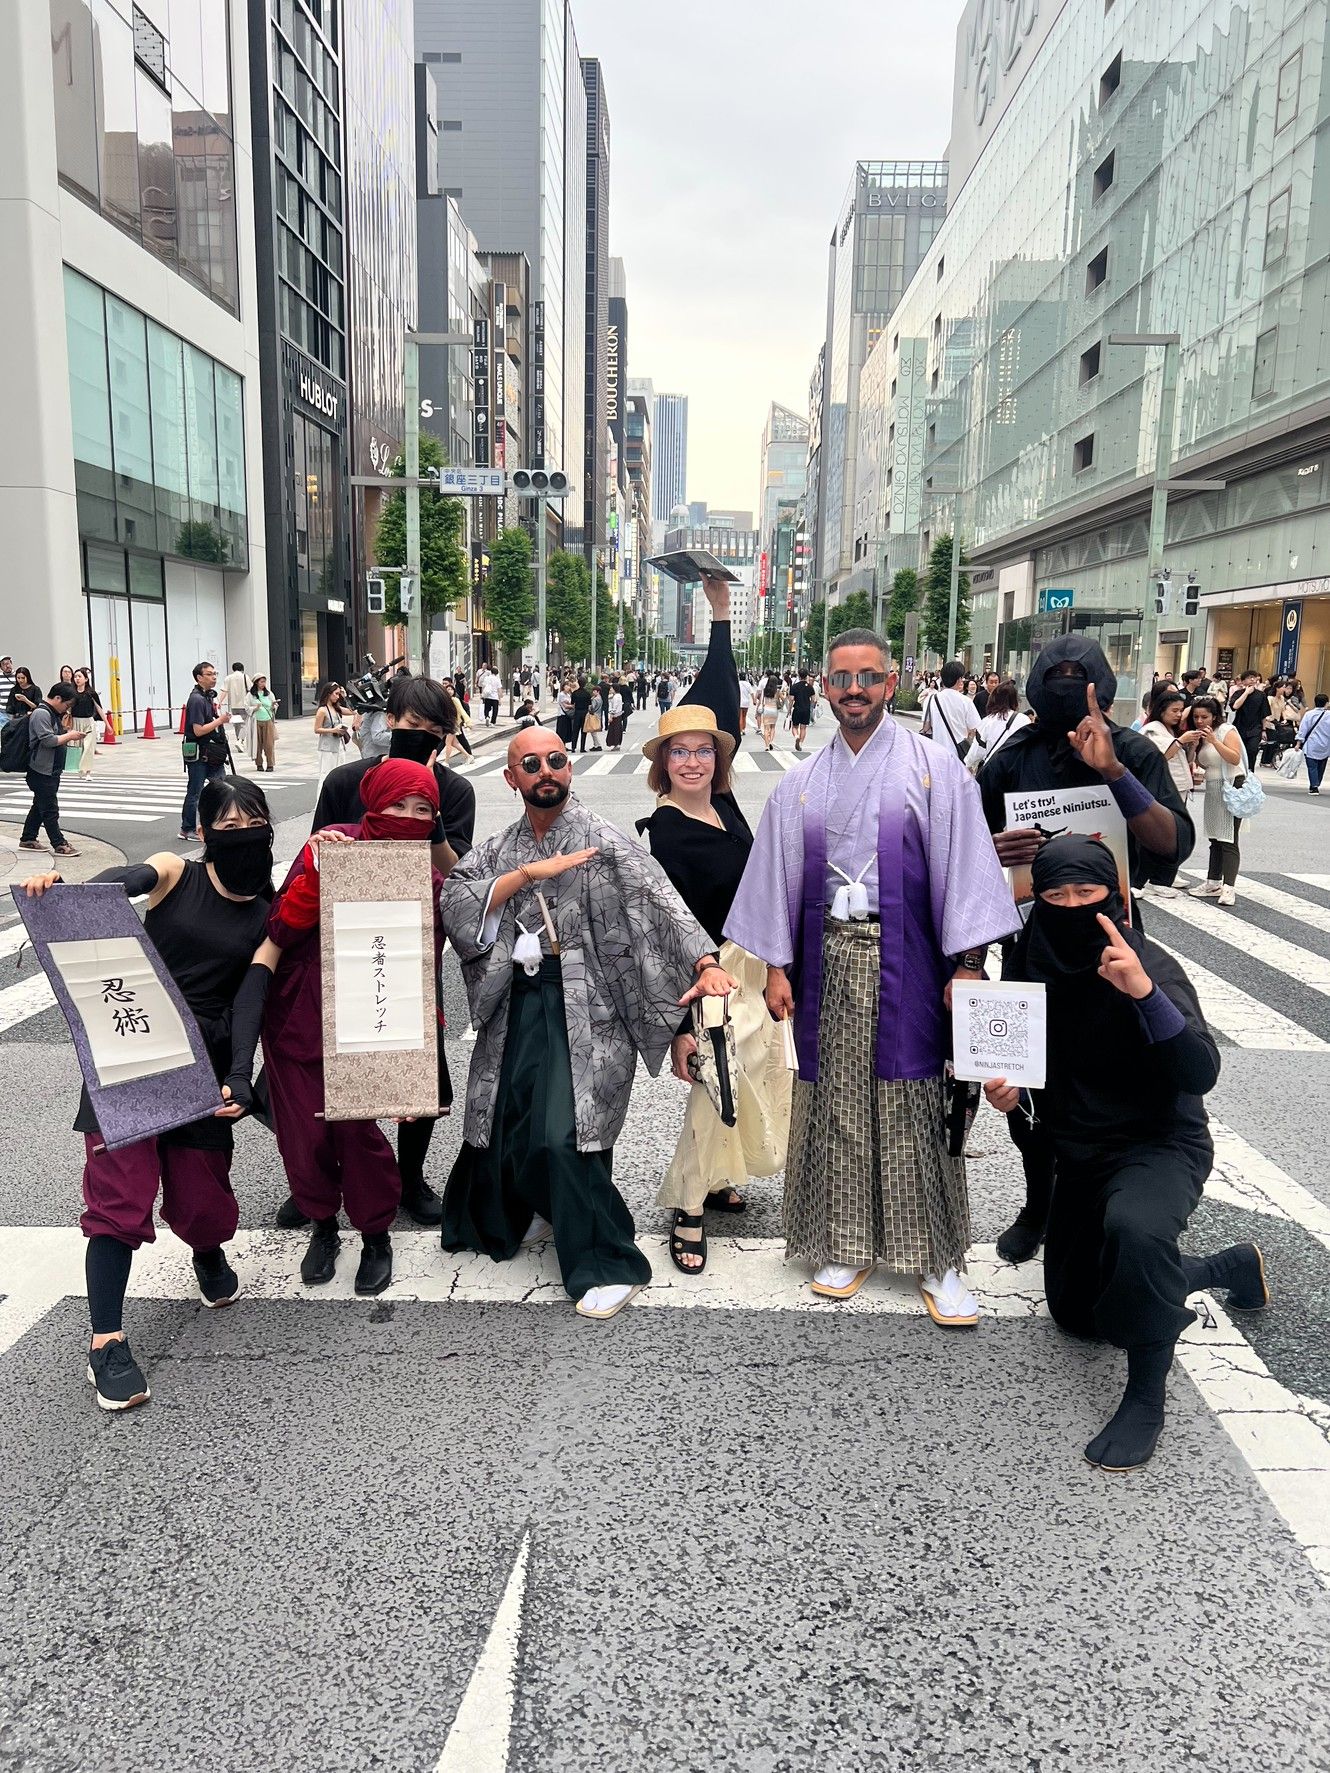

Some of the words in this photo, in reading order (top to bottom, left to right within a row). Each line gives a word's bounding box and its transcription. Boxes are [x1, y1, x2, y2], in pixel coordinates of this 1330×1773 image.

[869, 193, 947, 208] BVLG
[606, 325, 618, 420] BOUCHERON
[301, 372, 338, 420] HUBLOT
[445, 474, 500, 486] 銀座三丁目
[1013, 799, 1036, 811] Let's
[1038, 796, 1056, 807] try!
[1015, 806, 1061, 822] Japanese
[371, 935, 387, 1034] 忍者ストレッチ
[100, 978, 150, 1037] 忍術
[974, 1060, 1025, 1071] @NINJASTRETCH
